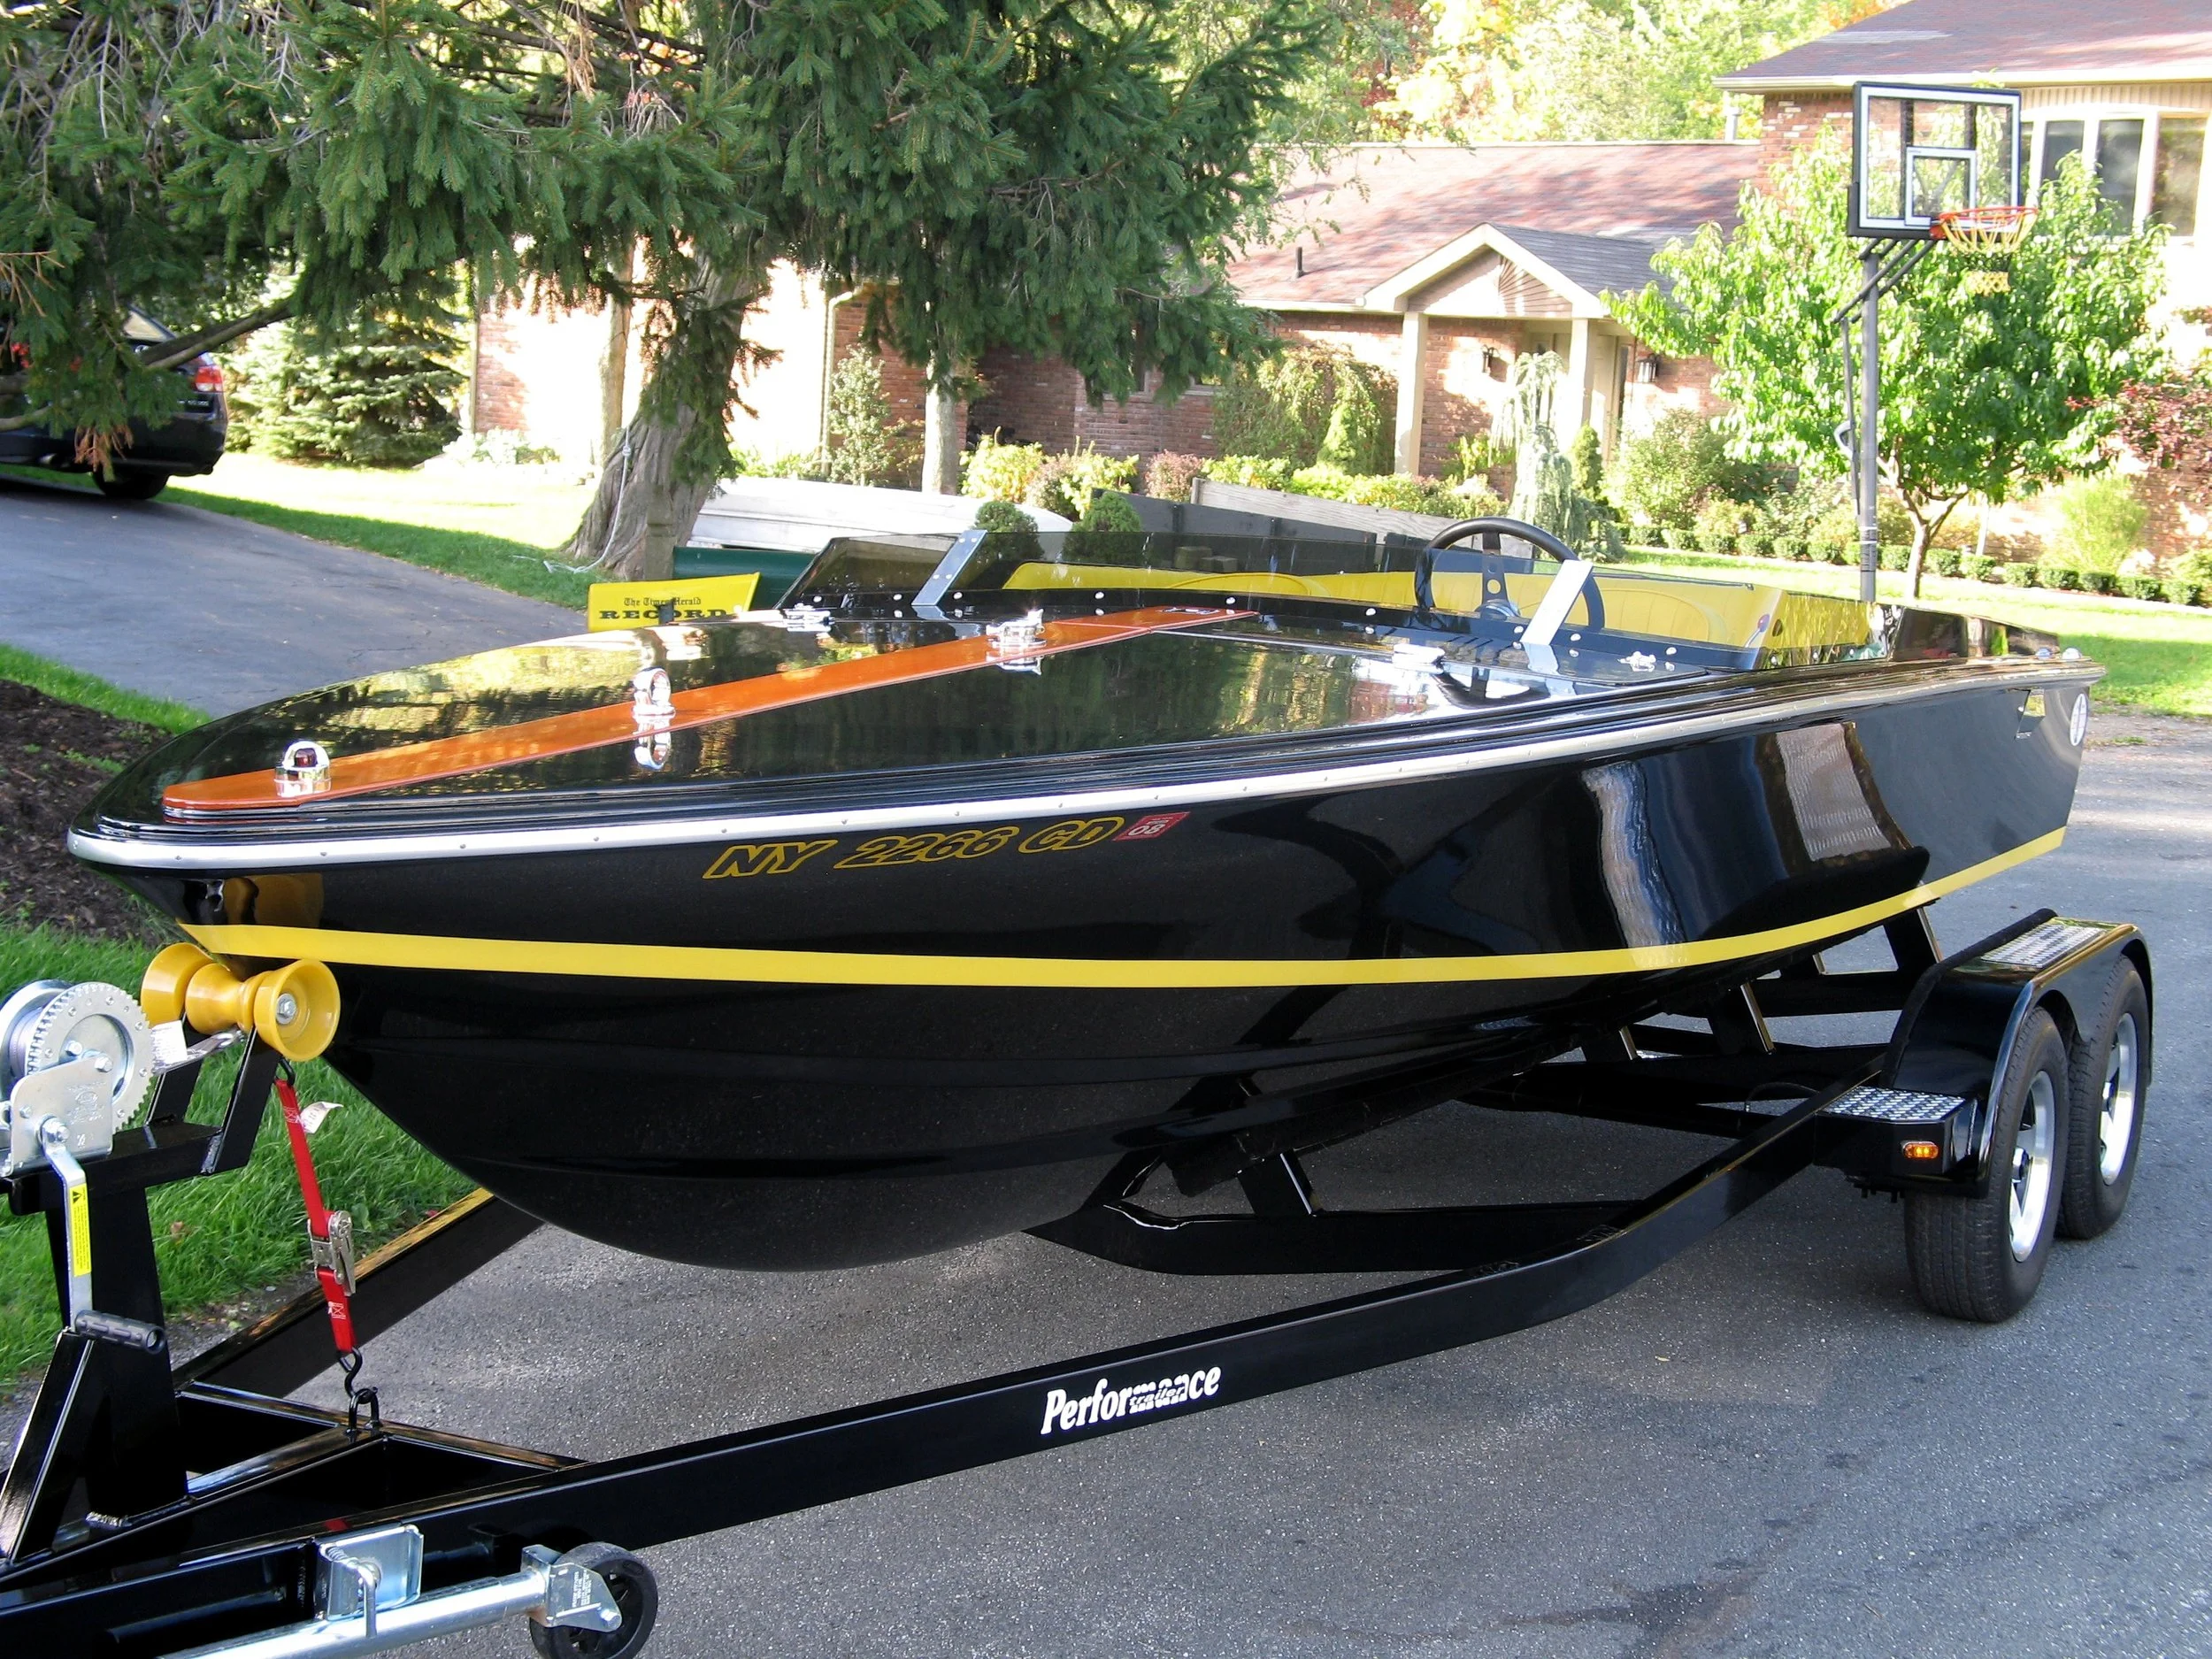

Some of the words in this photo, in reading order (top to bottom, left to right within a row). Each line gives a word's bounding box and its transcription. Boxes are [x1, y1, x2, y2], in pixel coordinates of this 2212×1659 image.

[624, 597, 640, 606] The
[1127, 824, 1166, 836] 08
[702, 839, 839, 879] NY
[833, 826, 1020, 870] 2266
[1129, 1386, 1185, 1407] trailer
